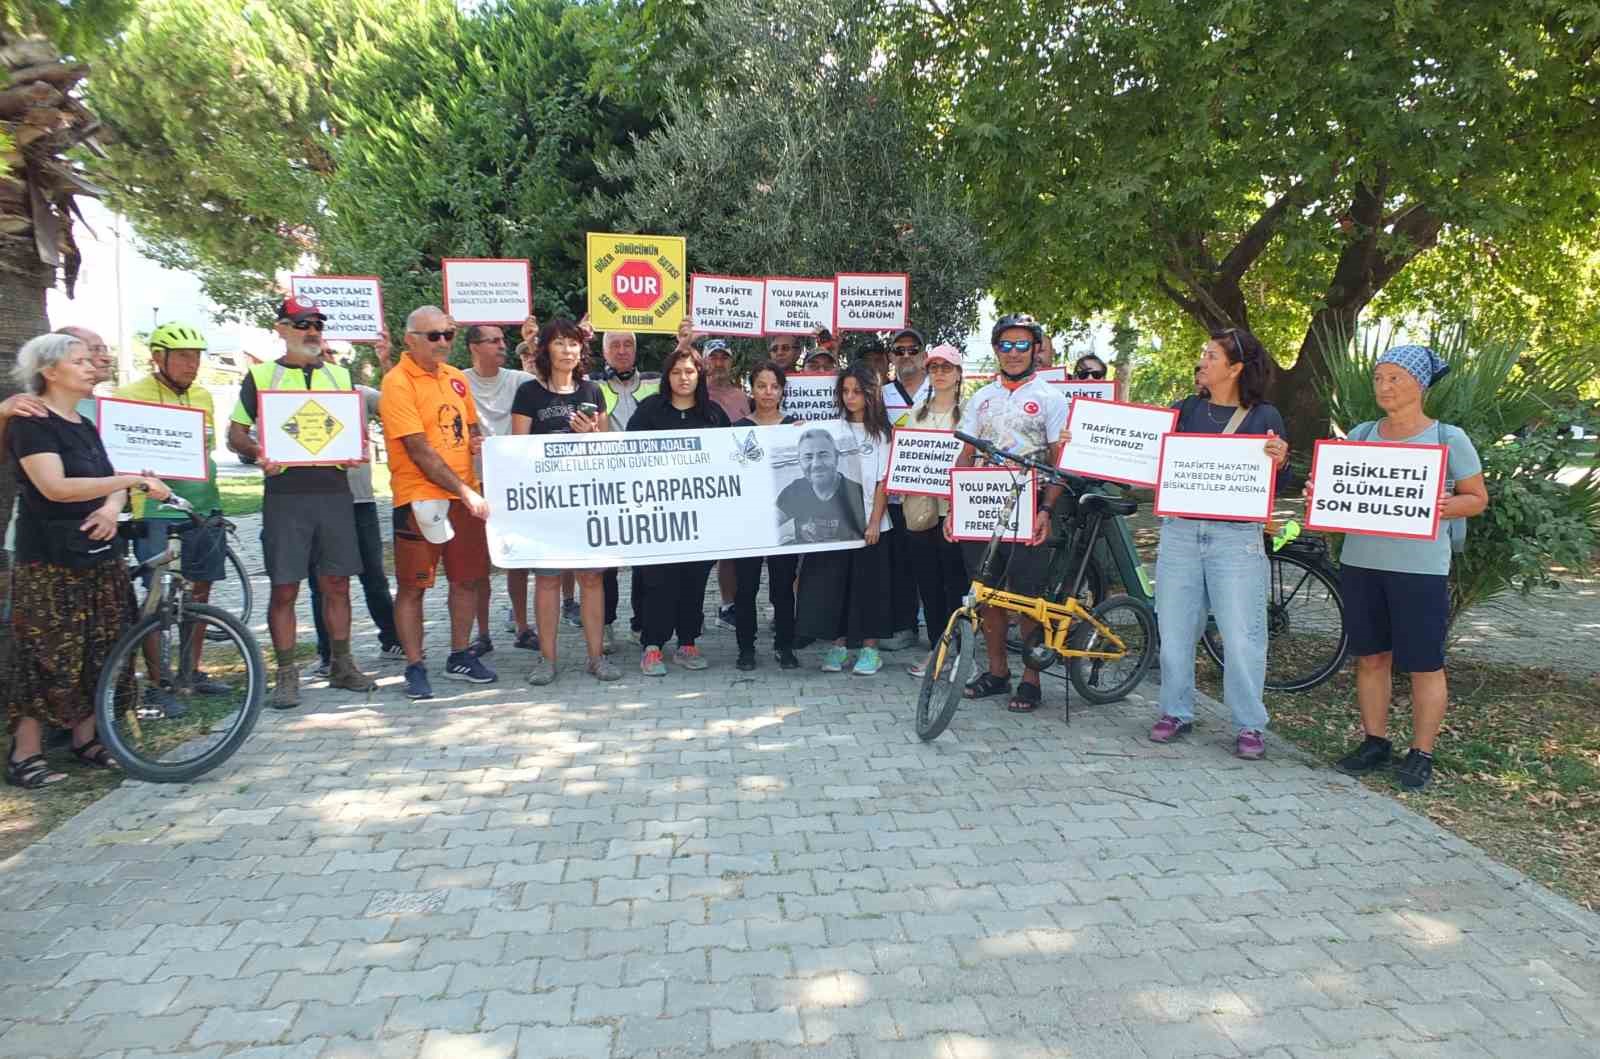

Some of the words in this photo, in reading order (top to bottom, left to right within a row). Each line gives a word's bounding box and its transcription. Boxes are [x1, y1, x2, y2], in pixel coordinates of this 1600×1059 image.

[616, 275, 658, 294] DUR
[705, 284, 753, 296] TRAFİKTE
[299, 286, 373, 296] KAPORTAMIZ
[771, 288, 793, 297] YOLU
[795, 289, 829, 300] PAYLAŞ!
[840, 285, 903, 297] BİSİKLETİME
[718, 296, 740, 306] SAĞ
[779, 299, 819, 308] KORNAYA
[840, 299, 903, 309] ÇARPARSAN
[338, 312, 375, 321] ÖLMEK
[696, 305, 724, 317] ŞERİT
[727, 309, 759, 318] YASAL
[786, 309, 811, 319] DEĞİL
[848, 310, 895, 319] ÖLÜRÜM!
[700, 319, 753, 329] HAKKIMIZ!
[775, 320, 801, 328] FRENE
[1063, 387, 1104, 399] AFİKTE
[1081, 422, 1128, 437] TRAFİKTE
[1129, 430, 1158, 441] SAYGI
[545, 442, 587, 458] SERKAN
[660, 437, 697, 451] ADALET
[897, 438, 961, 450] KAPORTAMIZ
[1089, 434, 1144, 450] İSTİYORUZ!
[672, 451, 712, 465] YOLLAR!
[899, 450, 954, 462] BEDENİMİZ!
[894, 464, 921, 473] ARTIK
[923, 464, 951, 476] ÖLME
[1173, 459, 1216, 470] TRAFİKTE
[1217, 462, 1260, 472] HAYATINI
[1332, 461, 1428, 481] BİSİKLETLİ
[1174, 471, 1222, 481] KAYBEDEN
[1225, 471, 1257, 482] BÜTÜN
[959, 482, 984, 492] YOLU
[1162, 480, 1226, 492] BİSİKLETLİLER
[1228, 484, 1267, 494] ANISINA
[1332, 480, 1425, 499] ÖLÜMLERİ
[506, 478, 627, 512] BİSİKLETİME
[632, 475, 742, 508] ÇARPARSAN
[969, 495, 1009, 505] KORNAY
[1316, 499, 1352, 513] SON
[1357, 501, 1431, 518] BULSUN
[586, 506, 700, 548] ÖLÜRÜM!
[964, 521, 994, 531] FRENE
